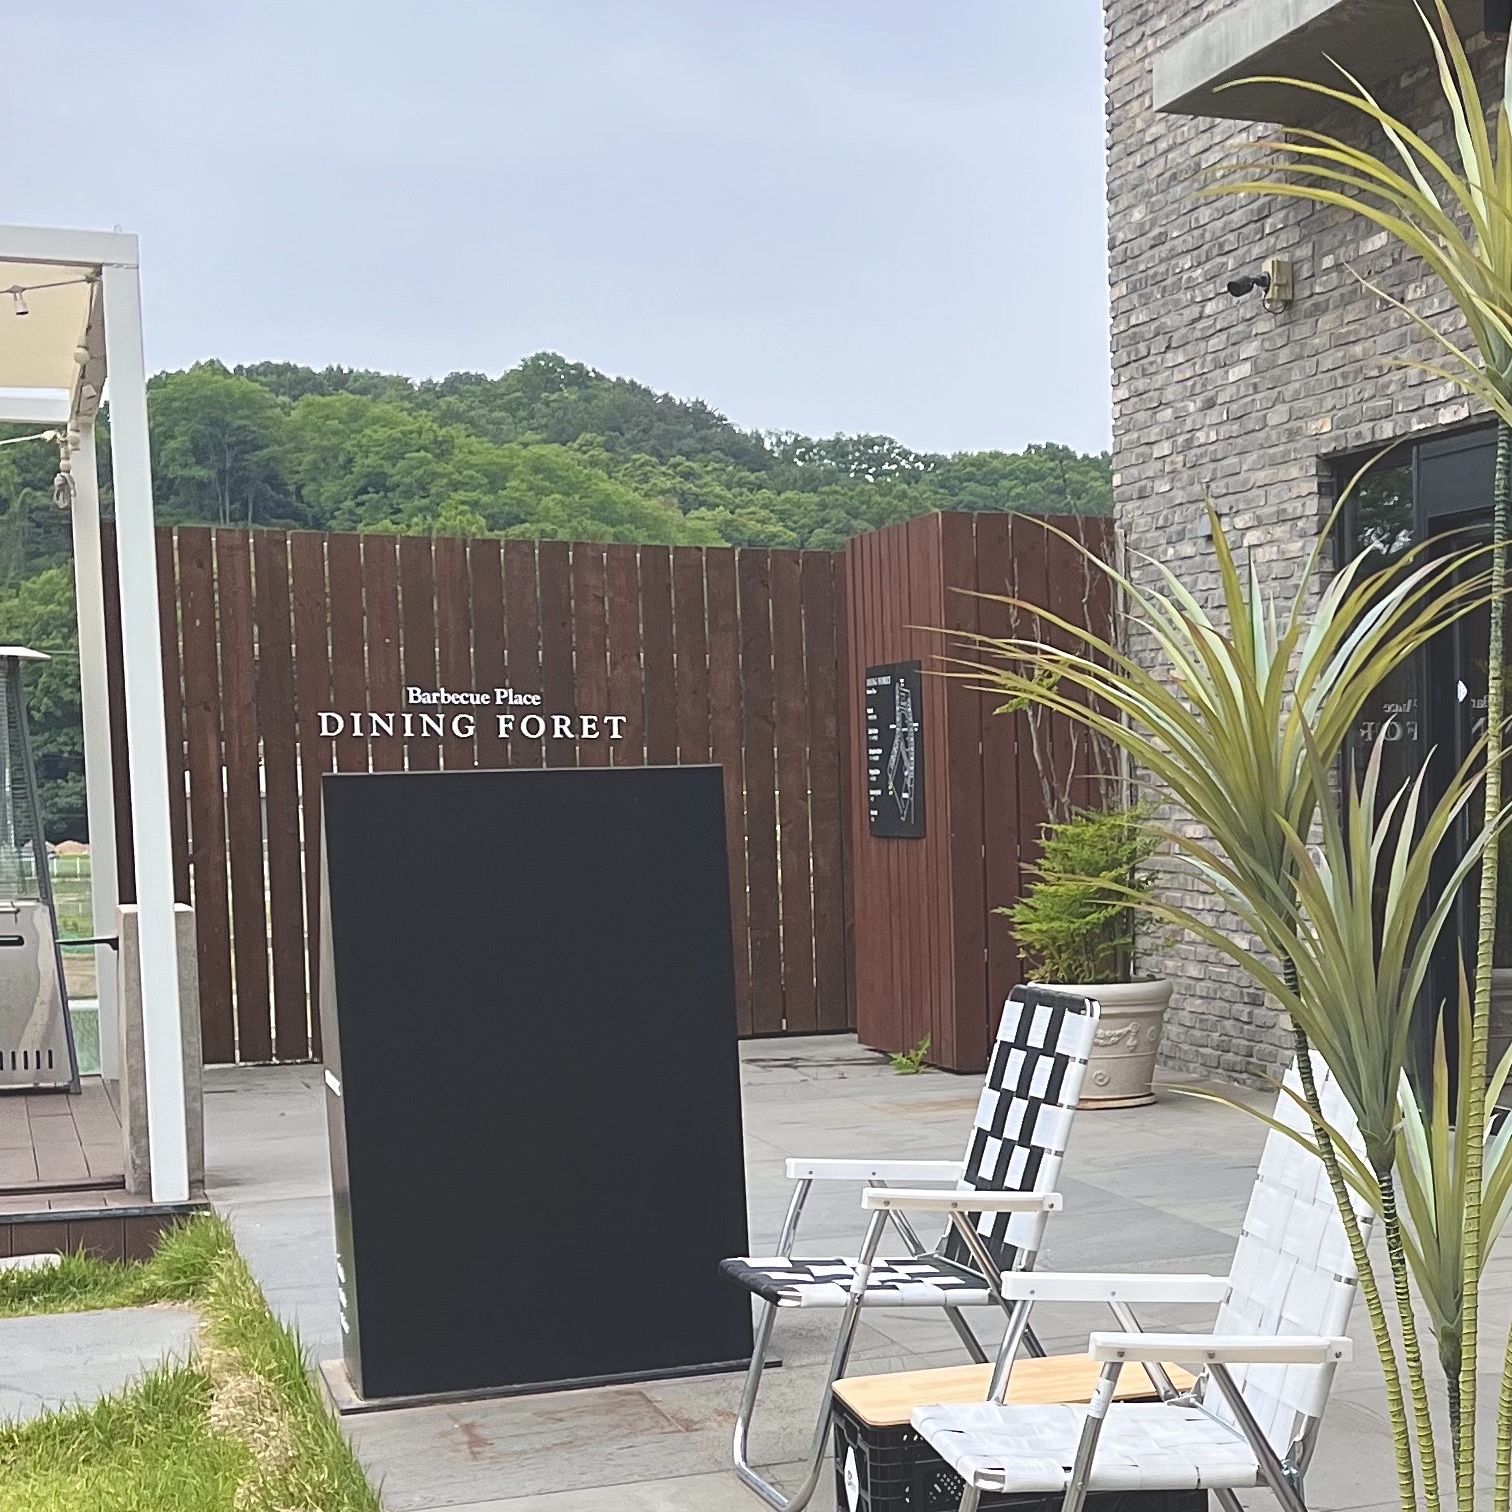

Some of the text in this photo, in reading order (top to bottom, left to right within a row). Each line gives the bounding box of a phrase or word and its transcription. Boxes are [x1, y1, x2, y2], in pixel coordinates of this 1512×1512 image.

[406, 686, 542, 706] Barbecue Place
[317, 711, 628, 740] DINING FORET
